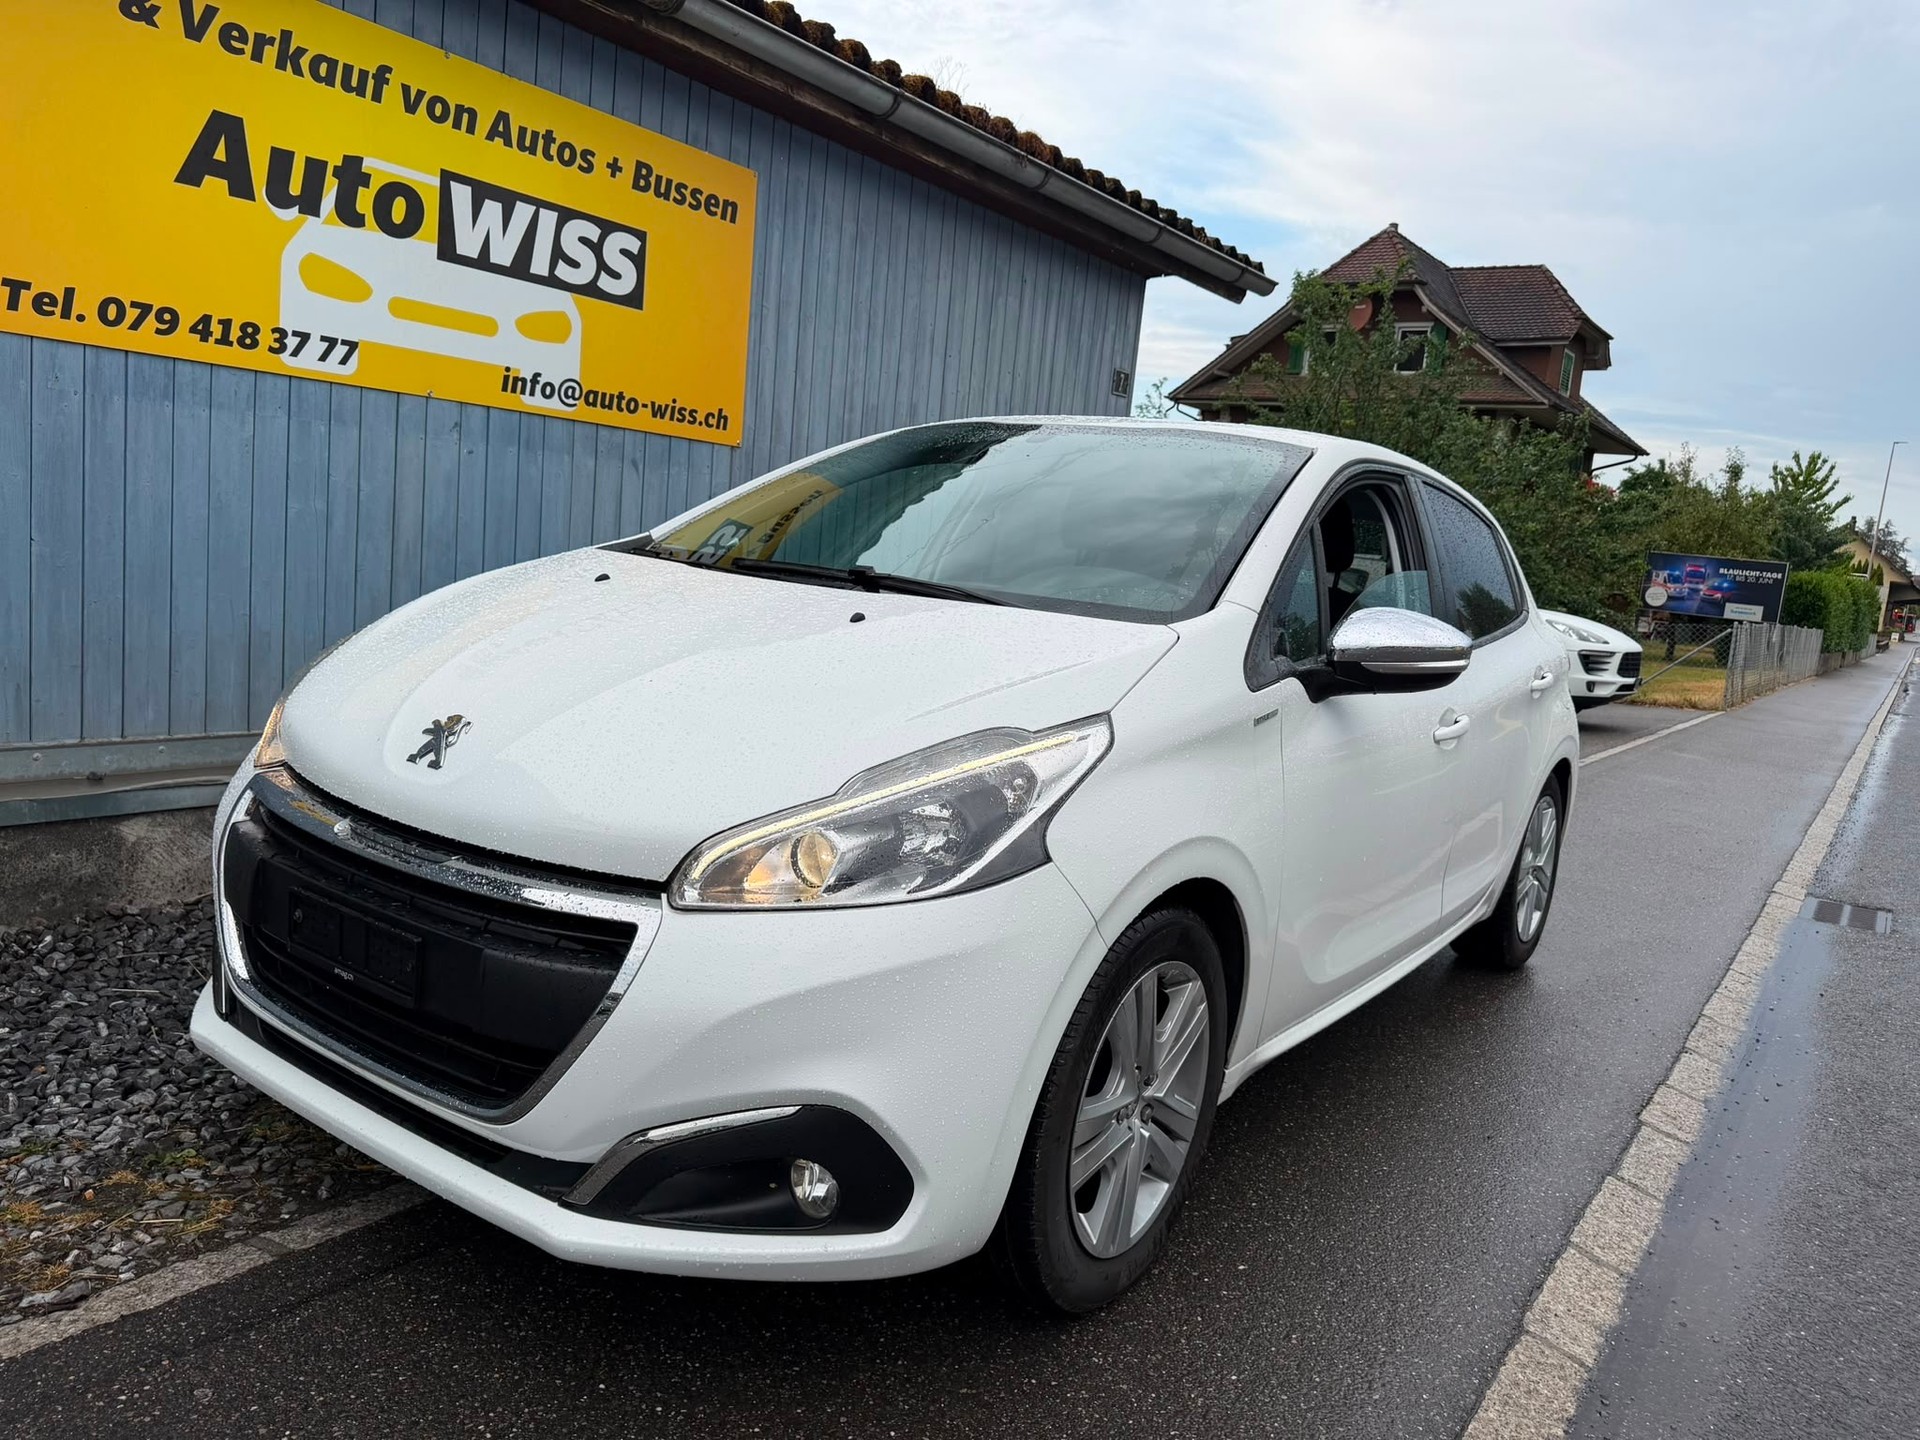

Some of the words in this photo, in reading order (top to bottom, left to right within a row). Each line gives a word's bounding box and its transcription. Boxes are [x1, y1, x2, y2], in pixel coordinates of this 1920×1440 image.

[118, 0, 162, 29] &
[179, 0, 393, 103] Verkauf
[400, 83, 478, 136] von
[485, 110, 596, 174] Autos
[606, 156, 623, 179] +
[632, 160, 738, 225] Bussen
[173, 109, 426, 239] Auto
[449, 180, 645, 298] WISS
[2, 277, 86, 323] Tel.
[97, 296, 180, 337] 079
[188, 313, 262, 351] 418
[267, 326, 312, 359] 37
[317, 334, 360, 367] 77
[500, 366, 729, 431] info@auto-wiss.ch
[1719, 568, 1782, 579] BLAULICHT-TAGE
